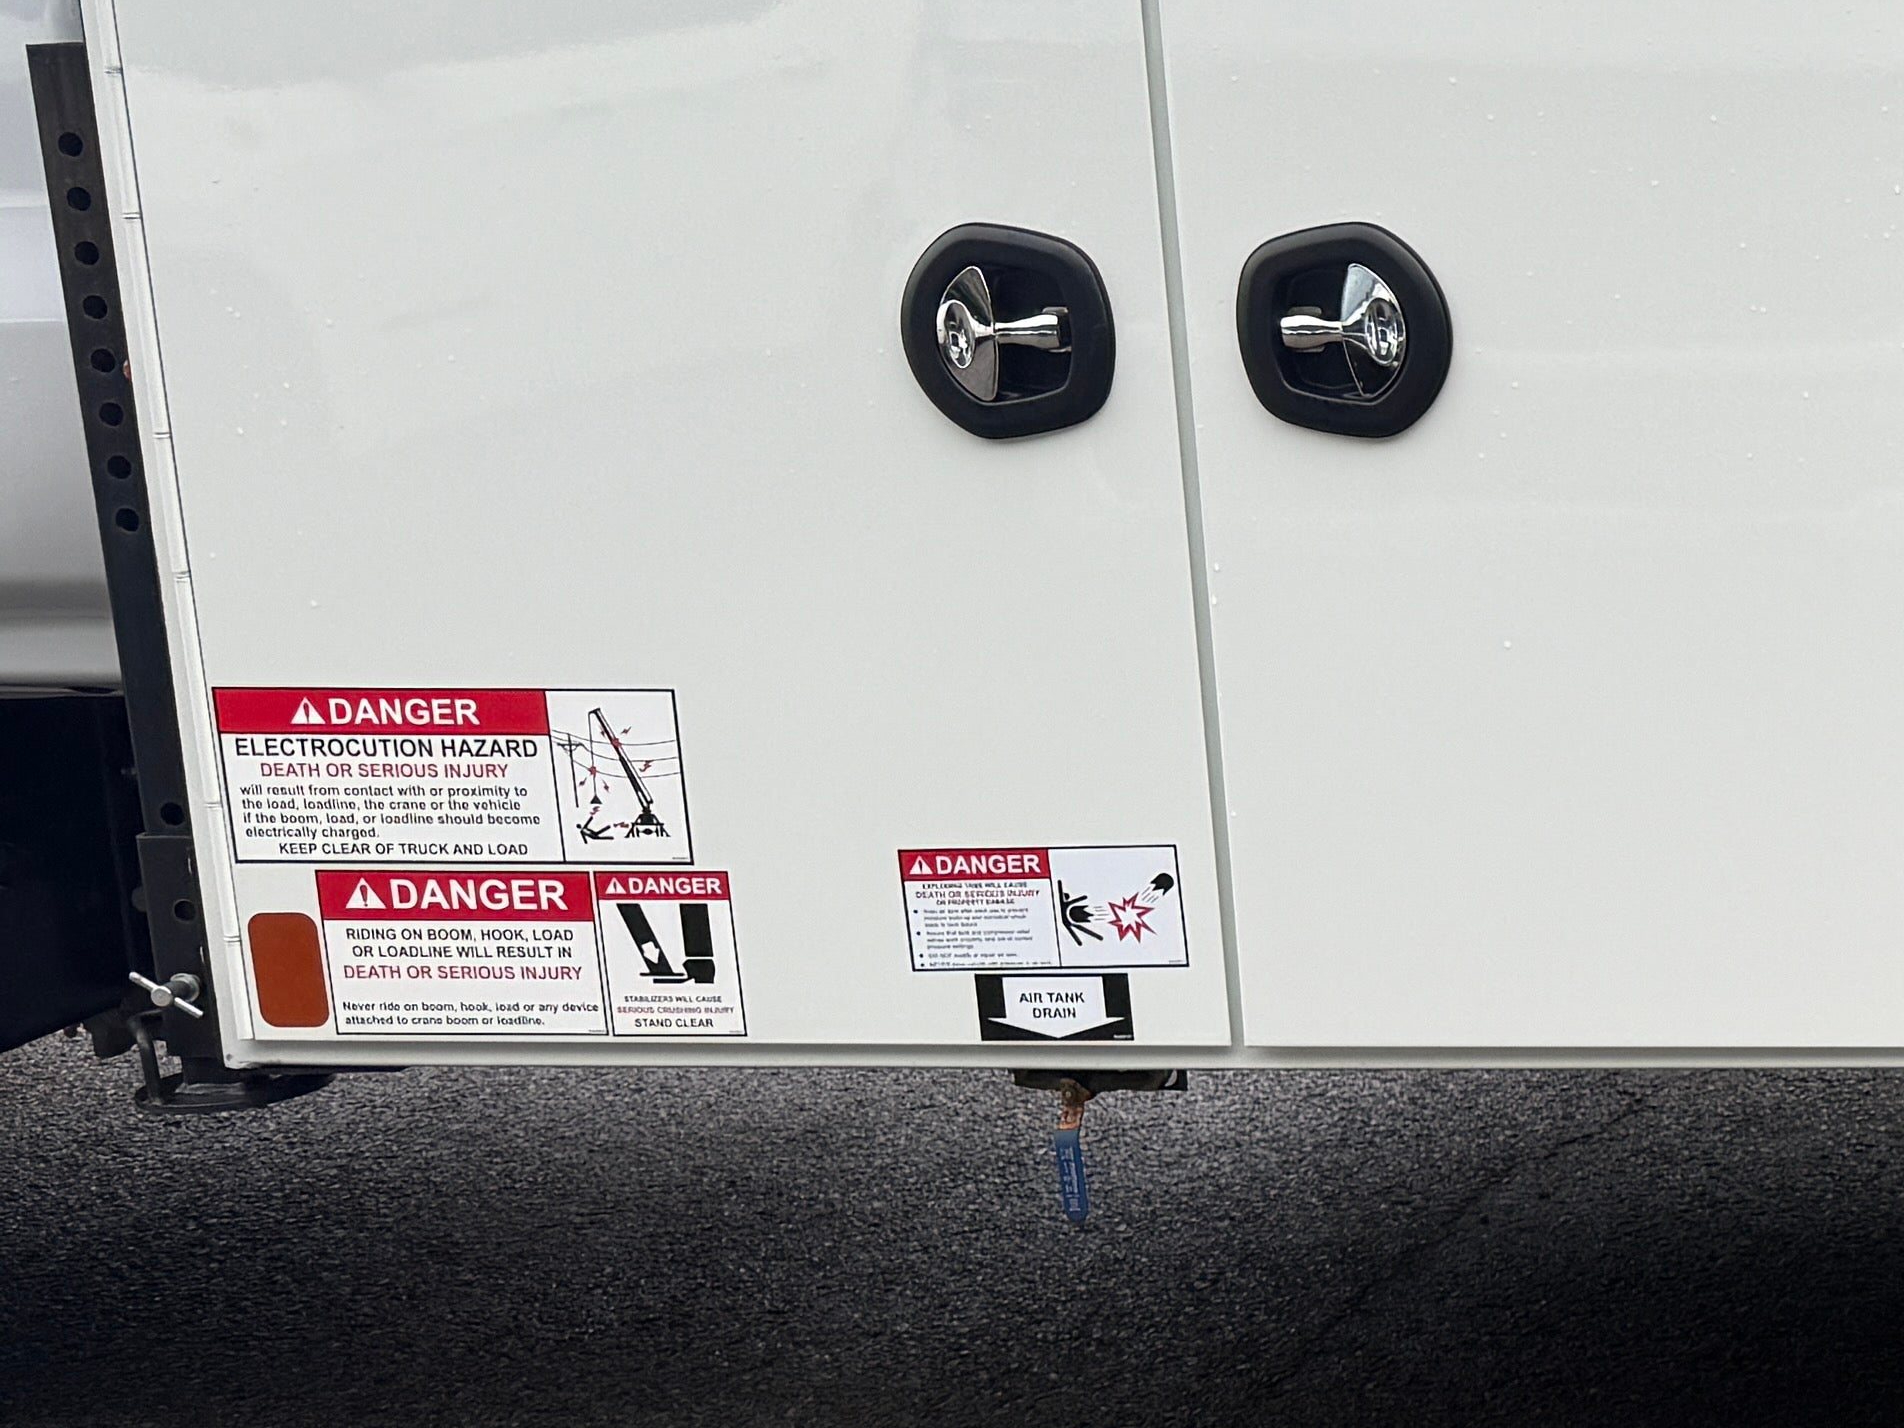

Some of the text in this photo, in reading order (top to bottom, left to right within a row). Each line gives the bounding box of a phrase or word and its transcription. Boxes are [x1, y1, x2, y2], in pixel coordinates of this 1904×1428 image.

[328, 698, 481, 725] DANGER
[235, 738, 539, 758] ELECTROCUTION HAZARD
[260, 763, 508, 778] DEATH OR SERIOUS INJURY
[240, 785, 528, 800] will result from contact with or proximity to
[242, 799, 521, 812] the load, loadline, the crane or the vehicle
[243, 813, 540, 826] if the boom, load, or loadline should become
[246, 826, 380, 840] electrically charged.
[279, 843, 528, 855] KEEP CLEAR OF TRUCK AND LOAD
[936, 855, 1041, 874] DANGER
[628, 877, 722, 894] DANGER
[389, 878, 569, 911] DANGER
[346, 928, 574, 943] RIDING ON BOOM, HOOK, LOAD
[352, 946, 572, 958] OR LOADLINE WILL RESULT IN
[344, 965, 582, 980] DEATH OR SERIOUS INJURY
[1019, 992, 1085, 1004] AIR TANK
[342, 1001, 599, 1014] Never ride on boom, hook, load or any device
[1032, 1007, 1076, 1019] DRAIN
[634, 1018, 714, 1028] STAND CLEAR
